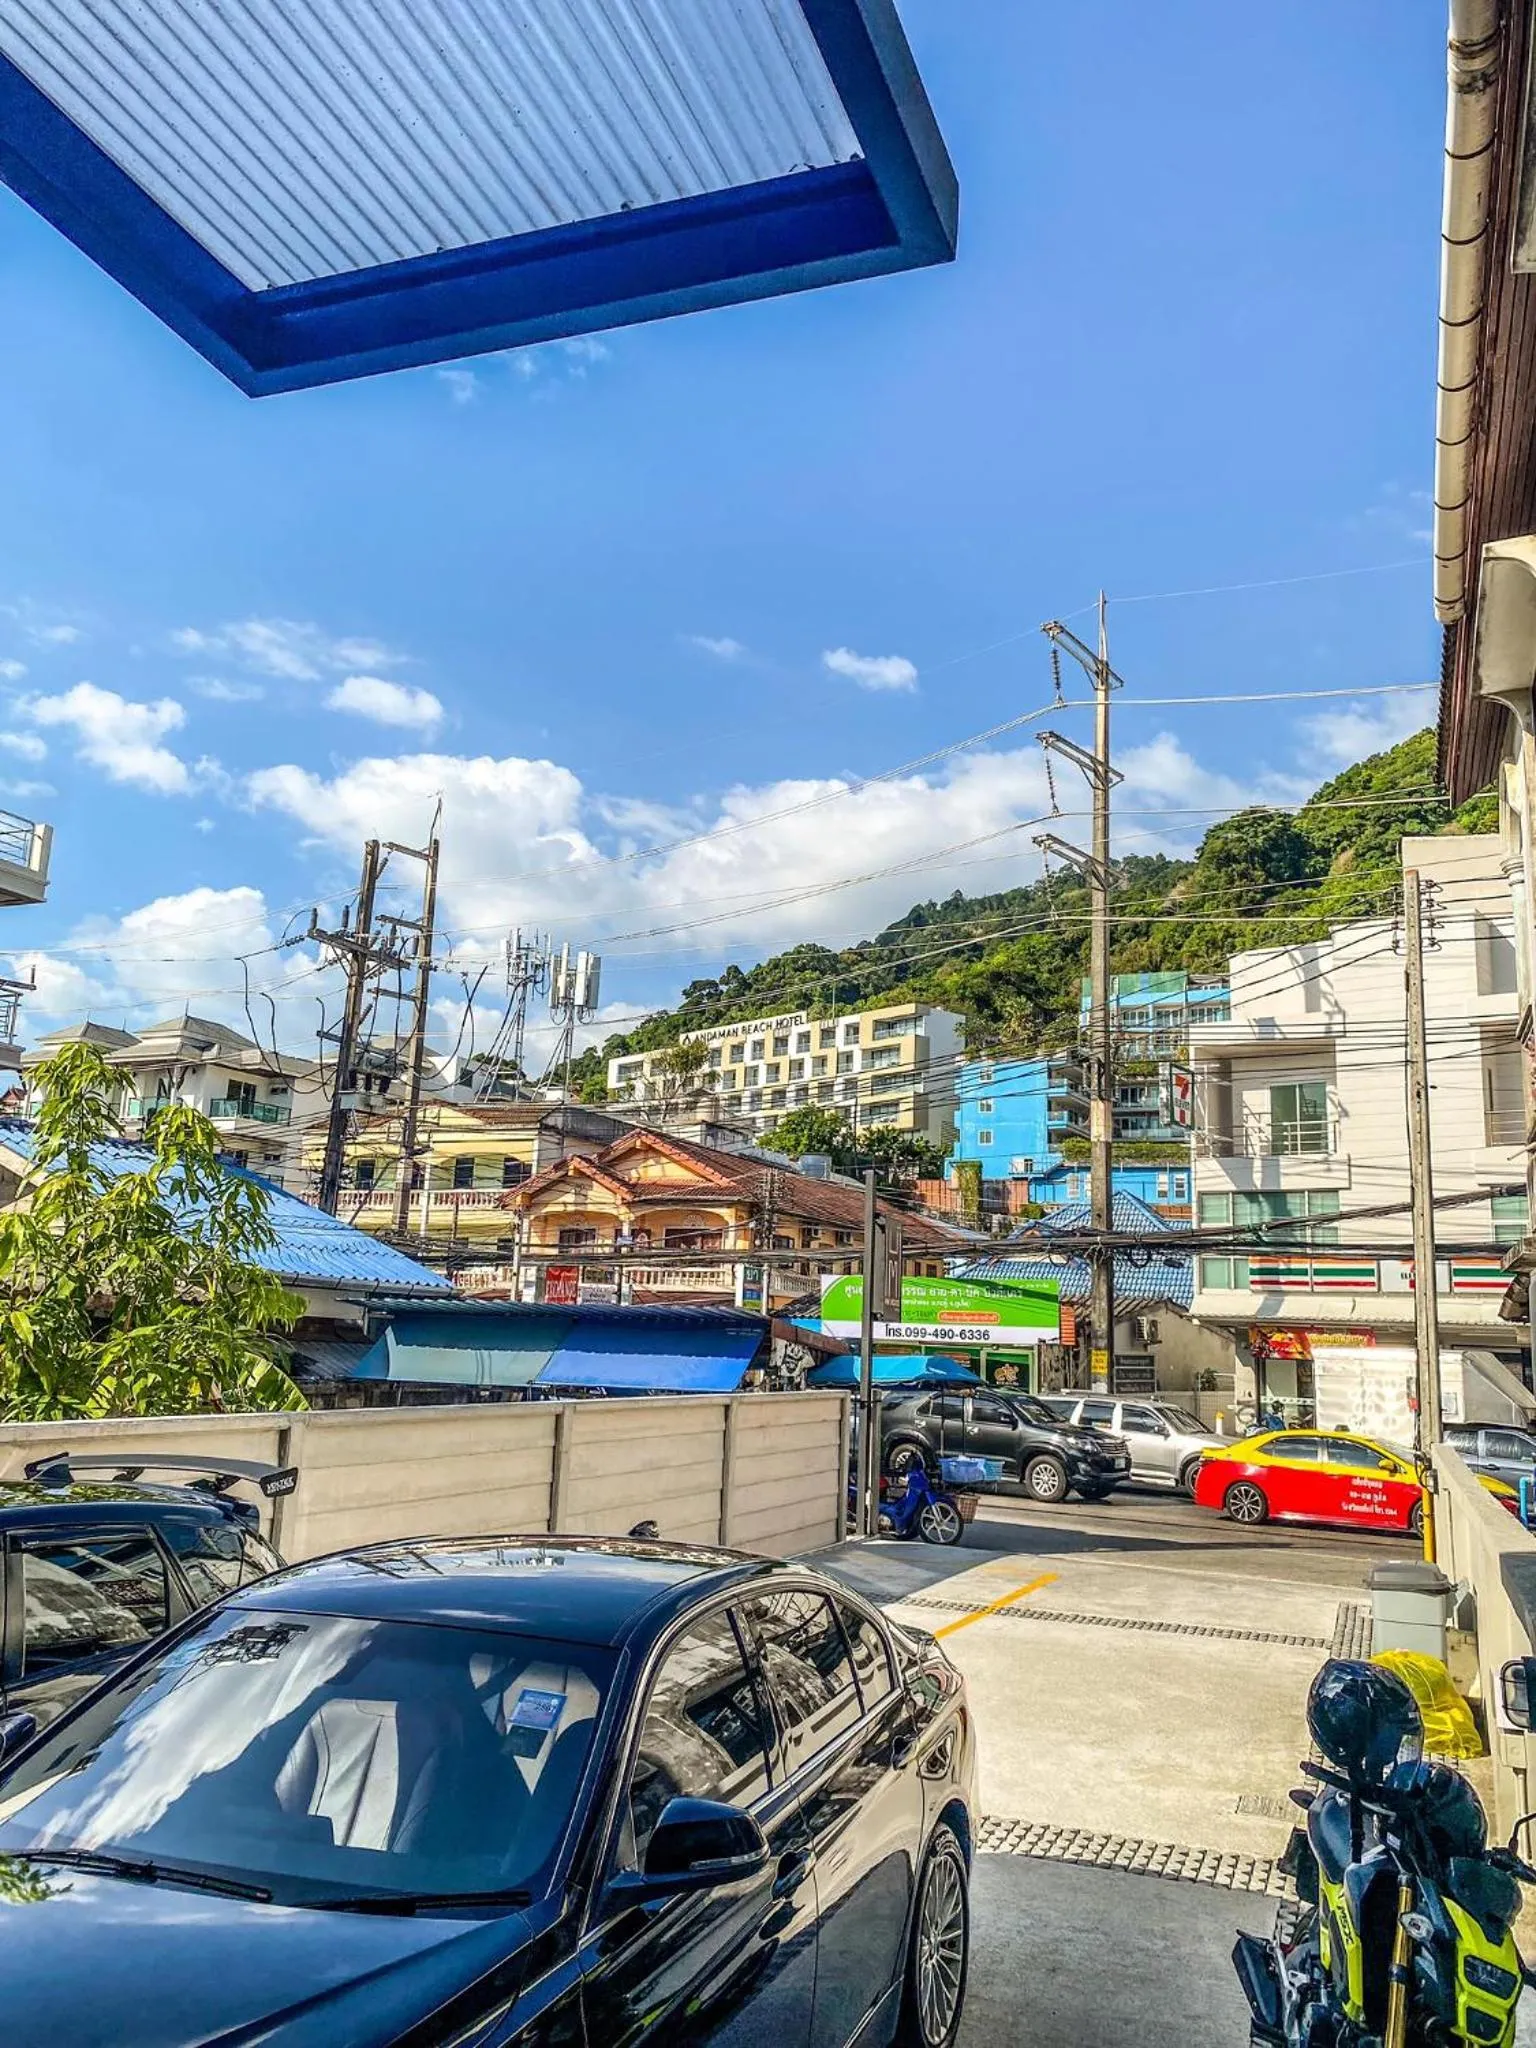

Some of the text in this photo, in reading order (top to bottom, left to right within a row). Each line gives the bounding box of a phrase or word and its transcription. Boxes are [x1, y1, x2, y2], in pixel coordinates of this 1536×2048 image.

[695, 1014, 805, 1042] ANDAMAN BEACH HOTEL
